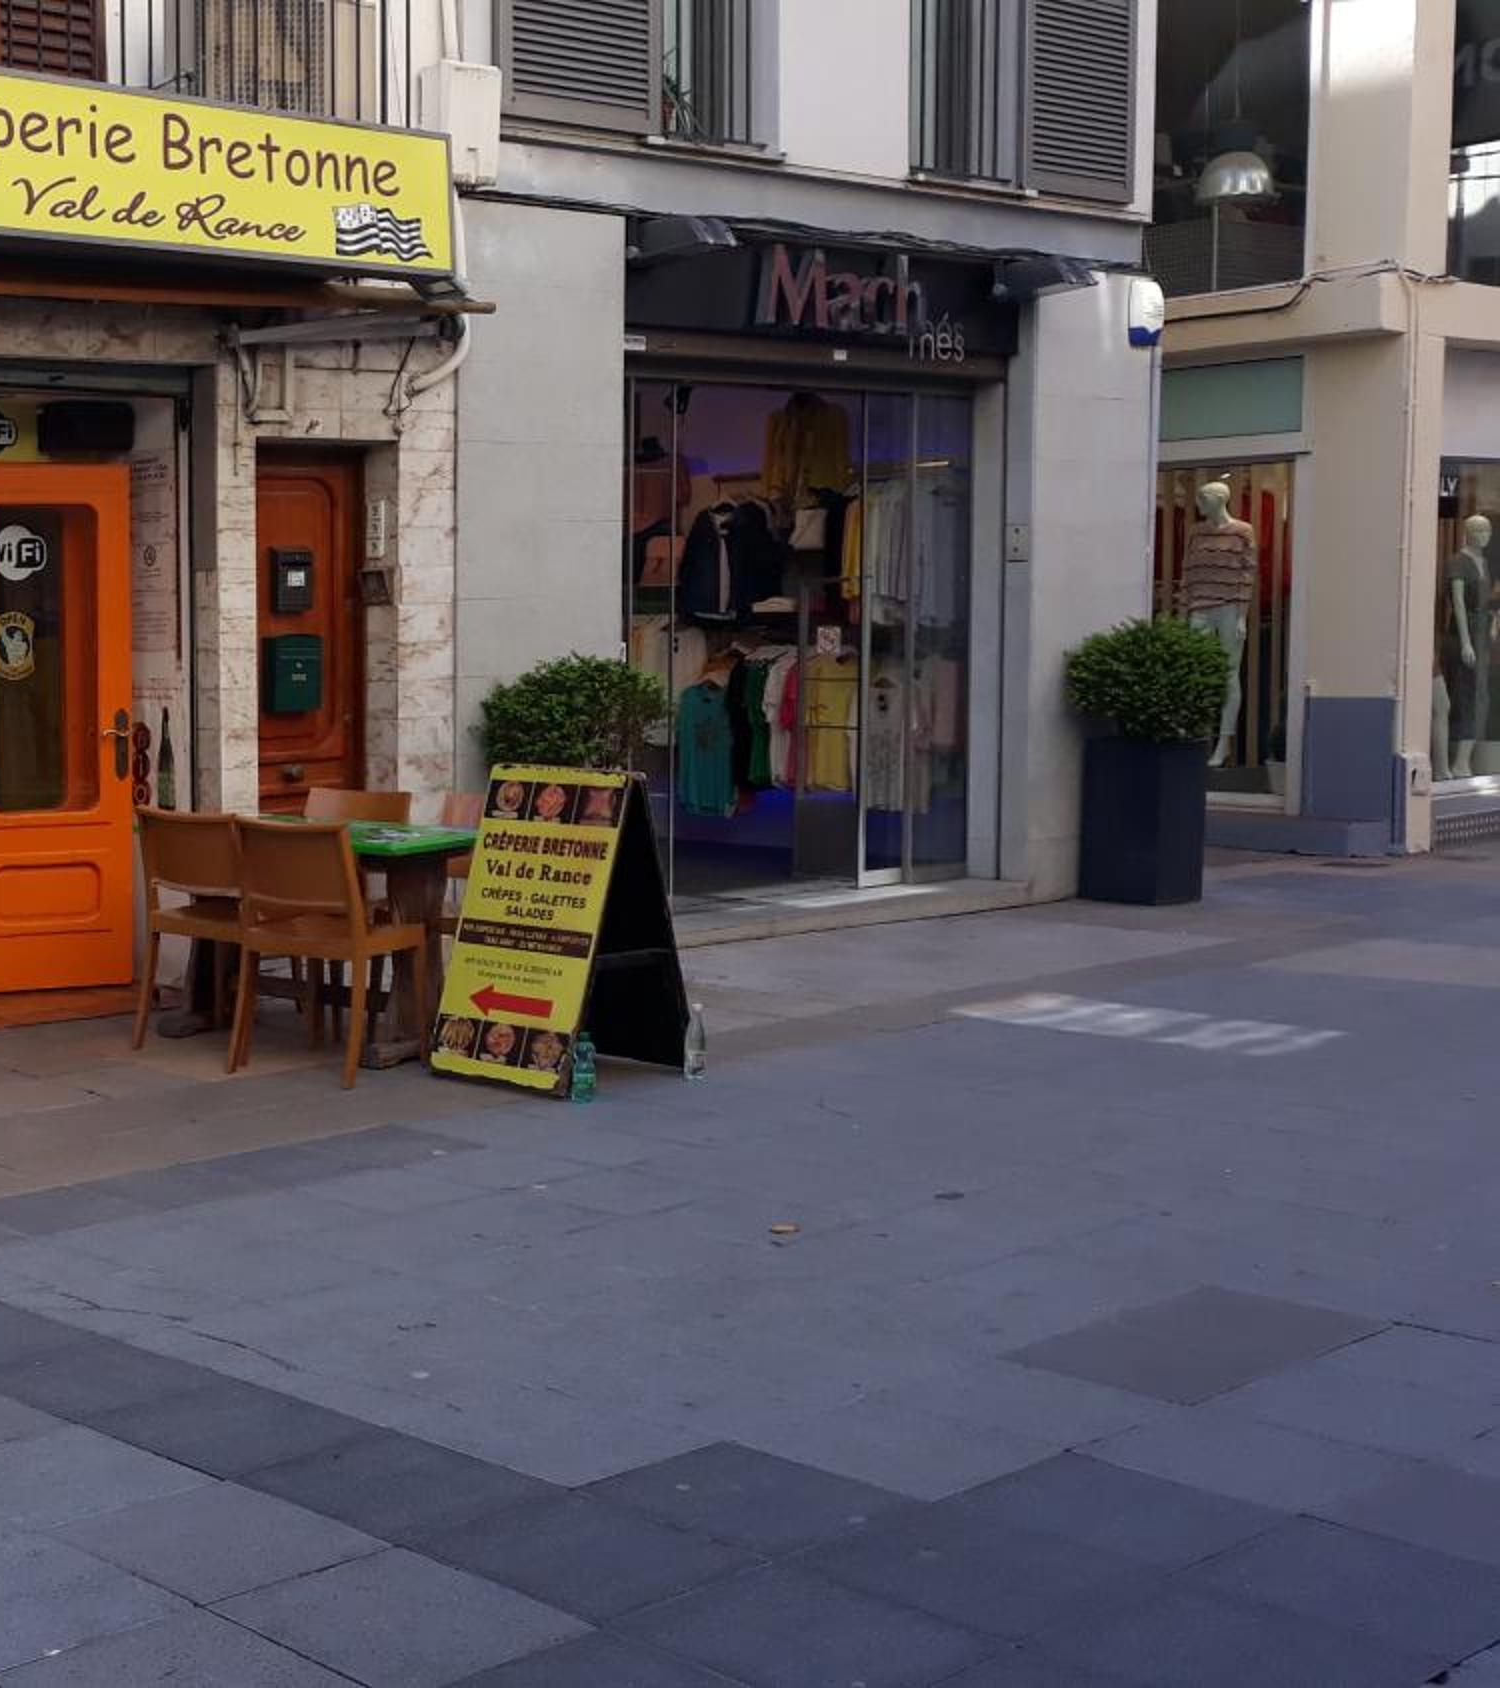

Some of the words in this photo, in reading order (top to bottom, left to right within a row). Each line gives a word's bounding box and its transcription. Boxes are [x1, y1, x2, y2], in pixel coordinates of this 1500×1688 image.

[162, 111, 401, 198] Bretonne
[11, 176, 106, 224] Val
[100, 191, 166, 230] de
[176, 195, 309, 244] Rance
[756, 243, 925, 336] Mach
[541, 837, 609, 860] BRETONNE
[486, 859, 512, 877] Val
[515, 862, 535, 880] de
[539, 864, 593, 886] Rance
[505, 905, 555, 921] SALADES
[530, 892, 587, 909] GALETTES
